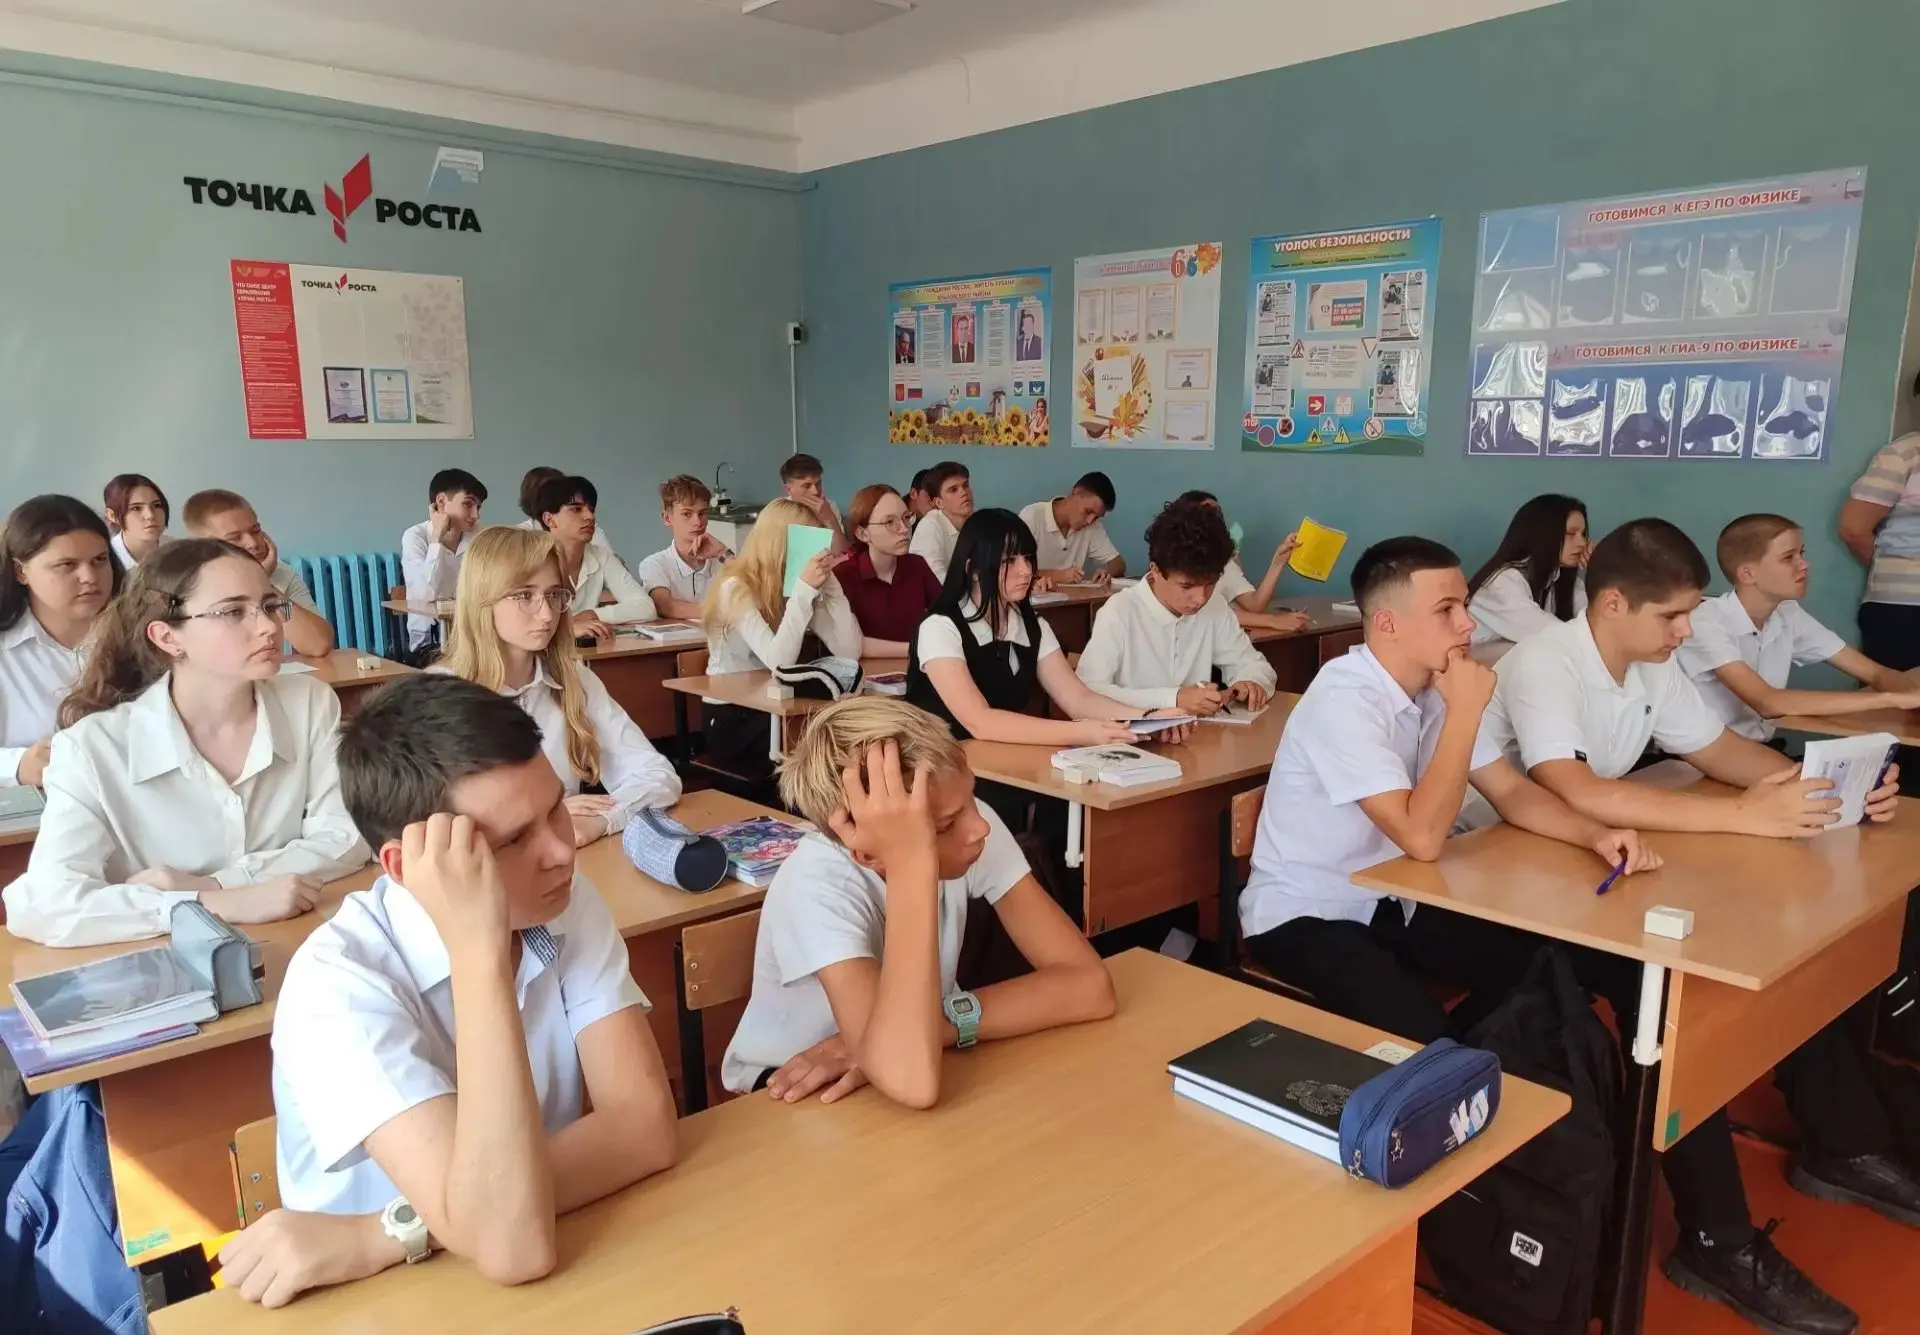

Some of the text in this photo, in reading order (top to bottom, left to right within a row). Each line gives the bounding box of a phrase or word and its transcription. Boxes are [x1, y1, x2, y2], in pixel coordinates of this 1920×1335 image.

[183, 176, 482, 232] ТОЧКА РОСТА
[1588, 189, 1799, 222] ГОТОВИМСЯ К ЕГЭ ПО ФИЗИКЕ
[1275, 229, 1411, 253] УГОЛОК БЕЗОПАСНОСТИ
[301, 280, 377, 292] ТОЧКА РОСТА
[1577, 338, 1798, 358] ГОТОВИМСЯ К ГИА-9 ПО ФИЗИКЕ
